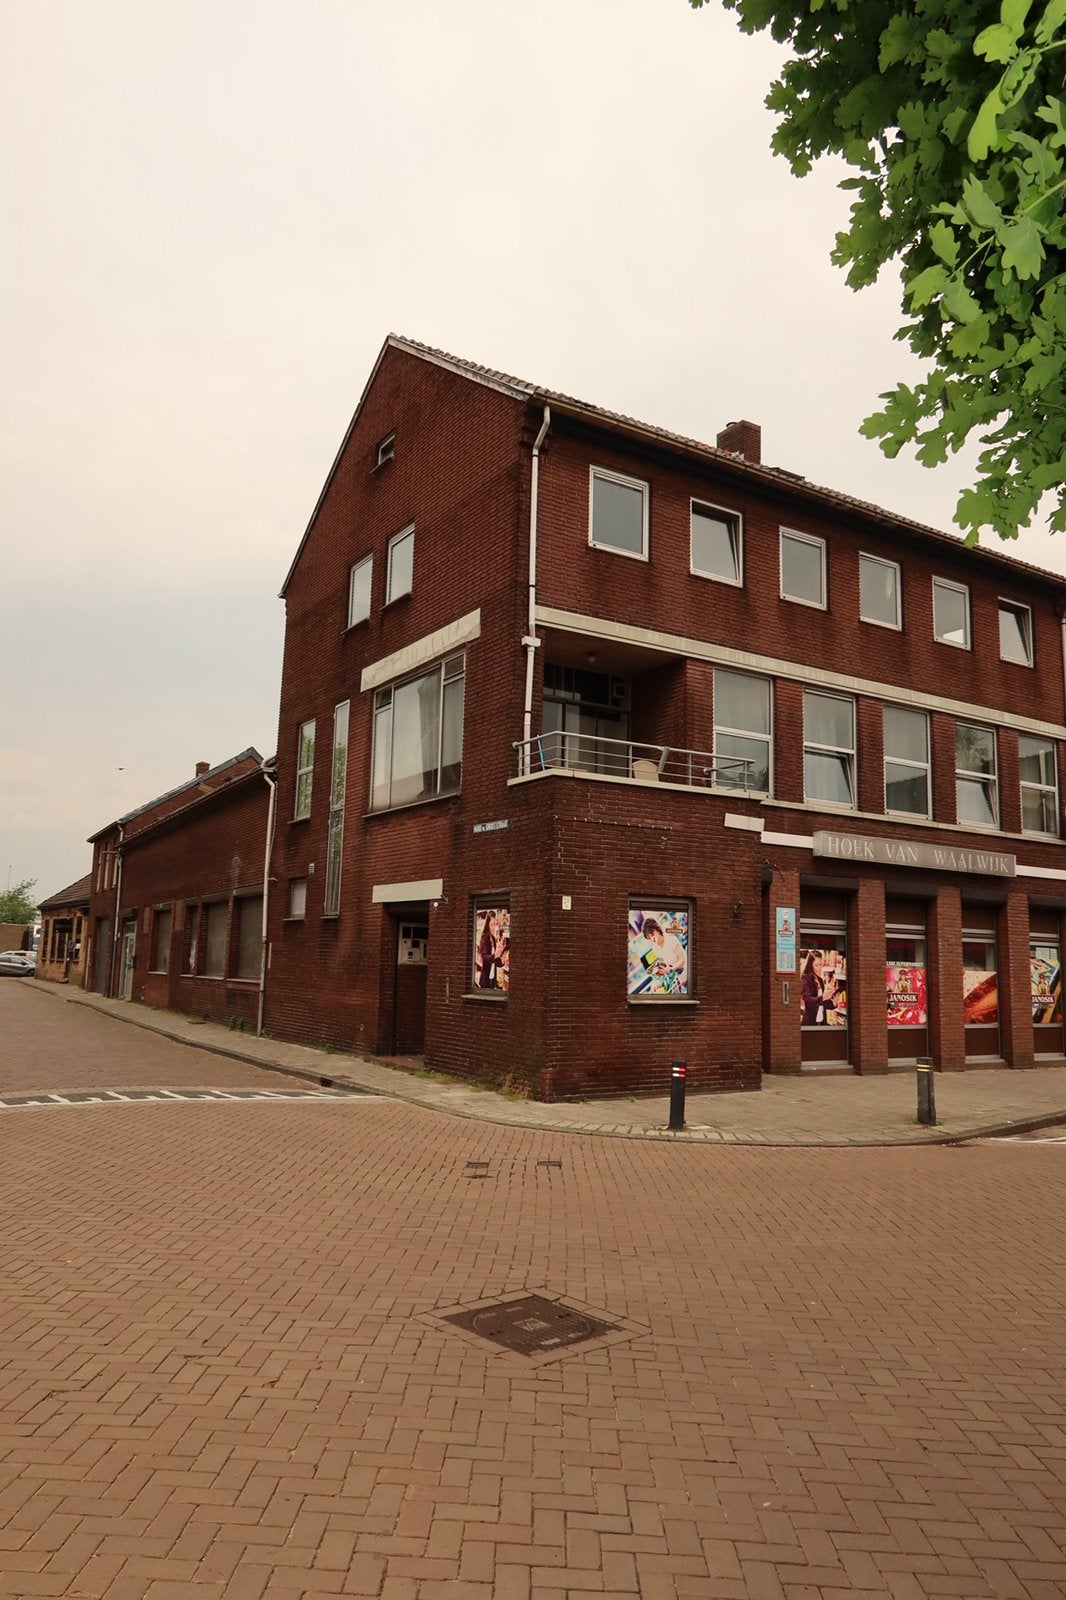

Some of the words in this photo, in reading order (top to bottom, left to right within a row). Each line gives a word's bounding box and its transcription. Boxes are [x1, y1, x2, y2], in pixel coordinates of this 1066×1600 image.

[827, 836, 874, 858] HOEK
[885, 843, 919, 862] VAN
[934, 849, 1009, 873] WAALWIJK
[888, 994, 918, 1002] JANOSIK
